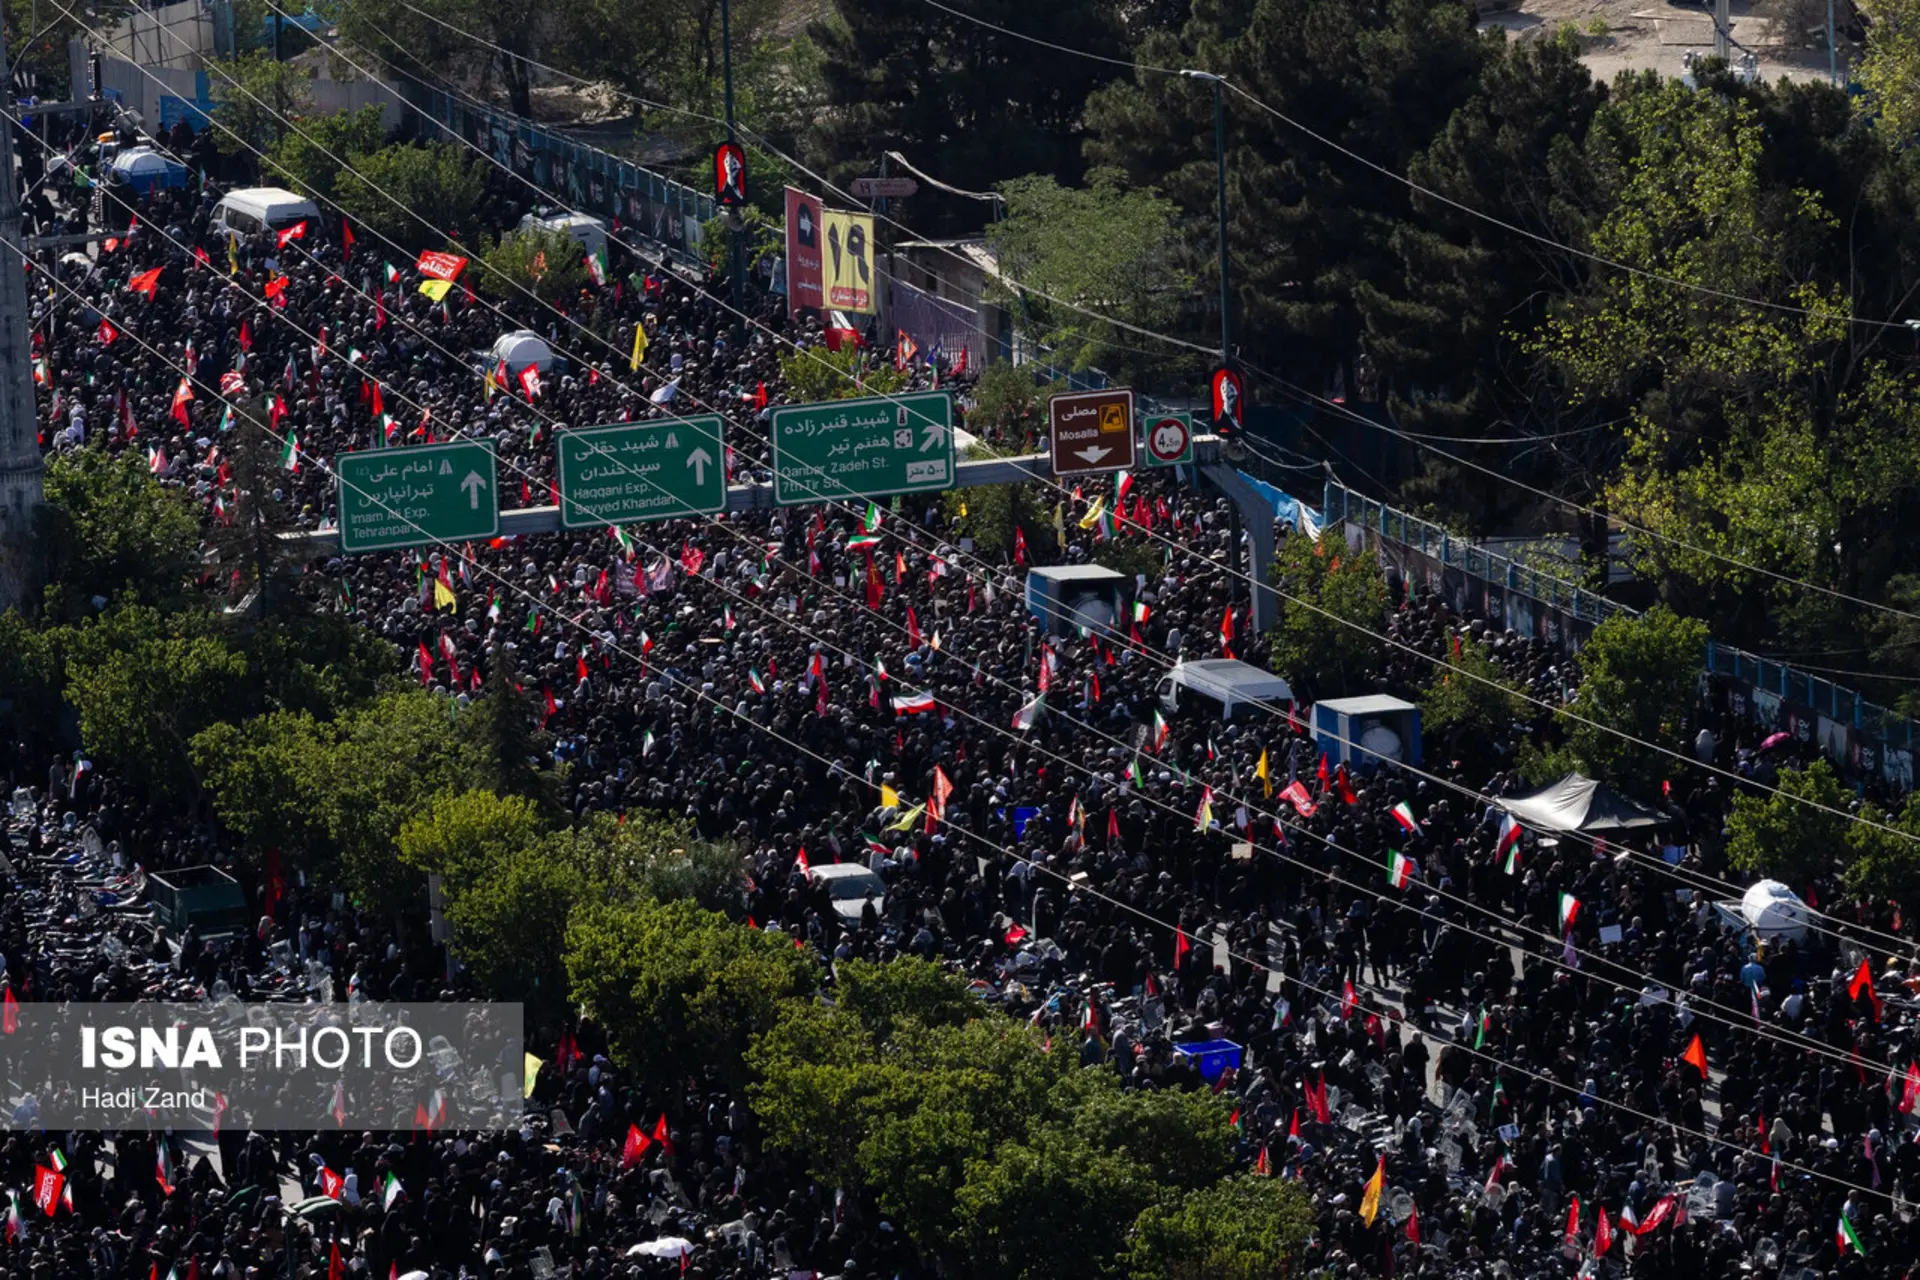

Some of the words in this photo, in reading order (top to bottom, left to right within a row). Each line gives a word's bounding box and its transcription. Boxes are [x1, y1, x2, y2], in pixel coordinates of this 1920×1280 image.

[828, 222, 869, 285] ۱۹
[851, 409, 890, 429] شهید
[1061, 406, 1097, 421] مصلی
[621, 434, 660, 454] شهید
[1059, 428, 1099, 441] Mosalla
[574, 440, 618, 461] حقانی
[827, 439, 850, 457] تیر
[854, 435, 890, 456] هفتم
[369, 464, 398, 483] علی
[402, 459, 433, 480] امام
[580, 463, 627, 481] خندان
[632, 461, 661, 475] سید
[781, 462, 825, 478] Qanbar
[831, 459, 869, 474] Zadeh
[872, 457, 889, 469] St.
[909, 468, 925, 479] متر
[927, 464, 944, 475] ۵۰۰
[573, 483, 622, 500] Haqqani
[625, 482, 651, 496] Exp.
[804, 479, 820, 490] Tir
[359, 483, 434, 507] تهرانپارس
[574, 499, 620, 516] Seyyed
[622, 494, 676, 510] Khandan
[351, 511, 383, 525] Imam
[387, 508, 401, 521] Ali
[404, 506, 431, 520] Exp.
[353, 523, 420, 540] Tehranpars
